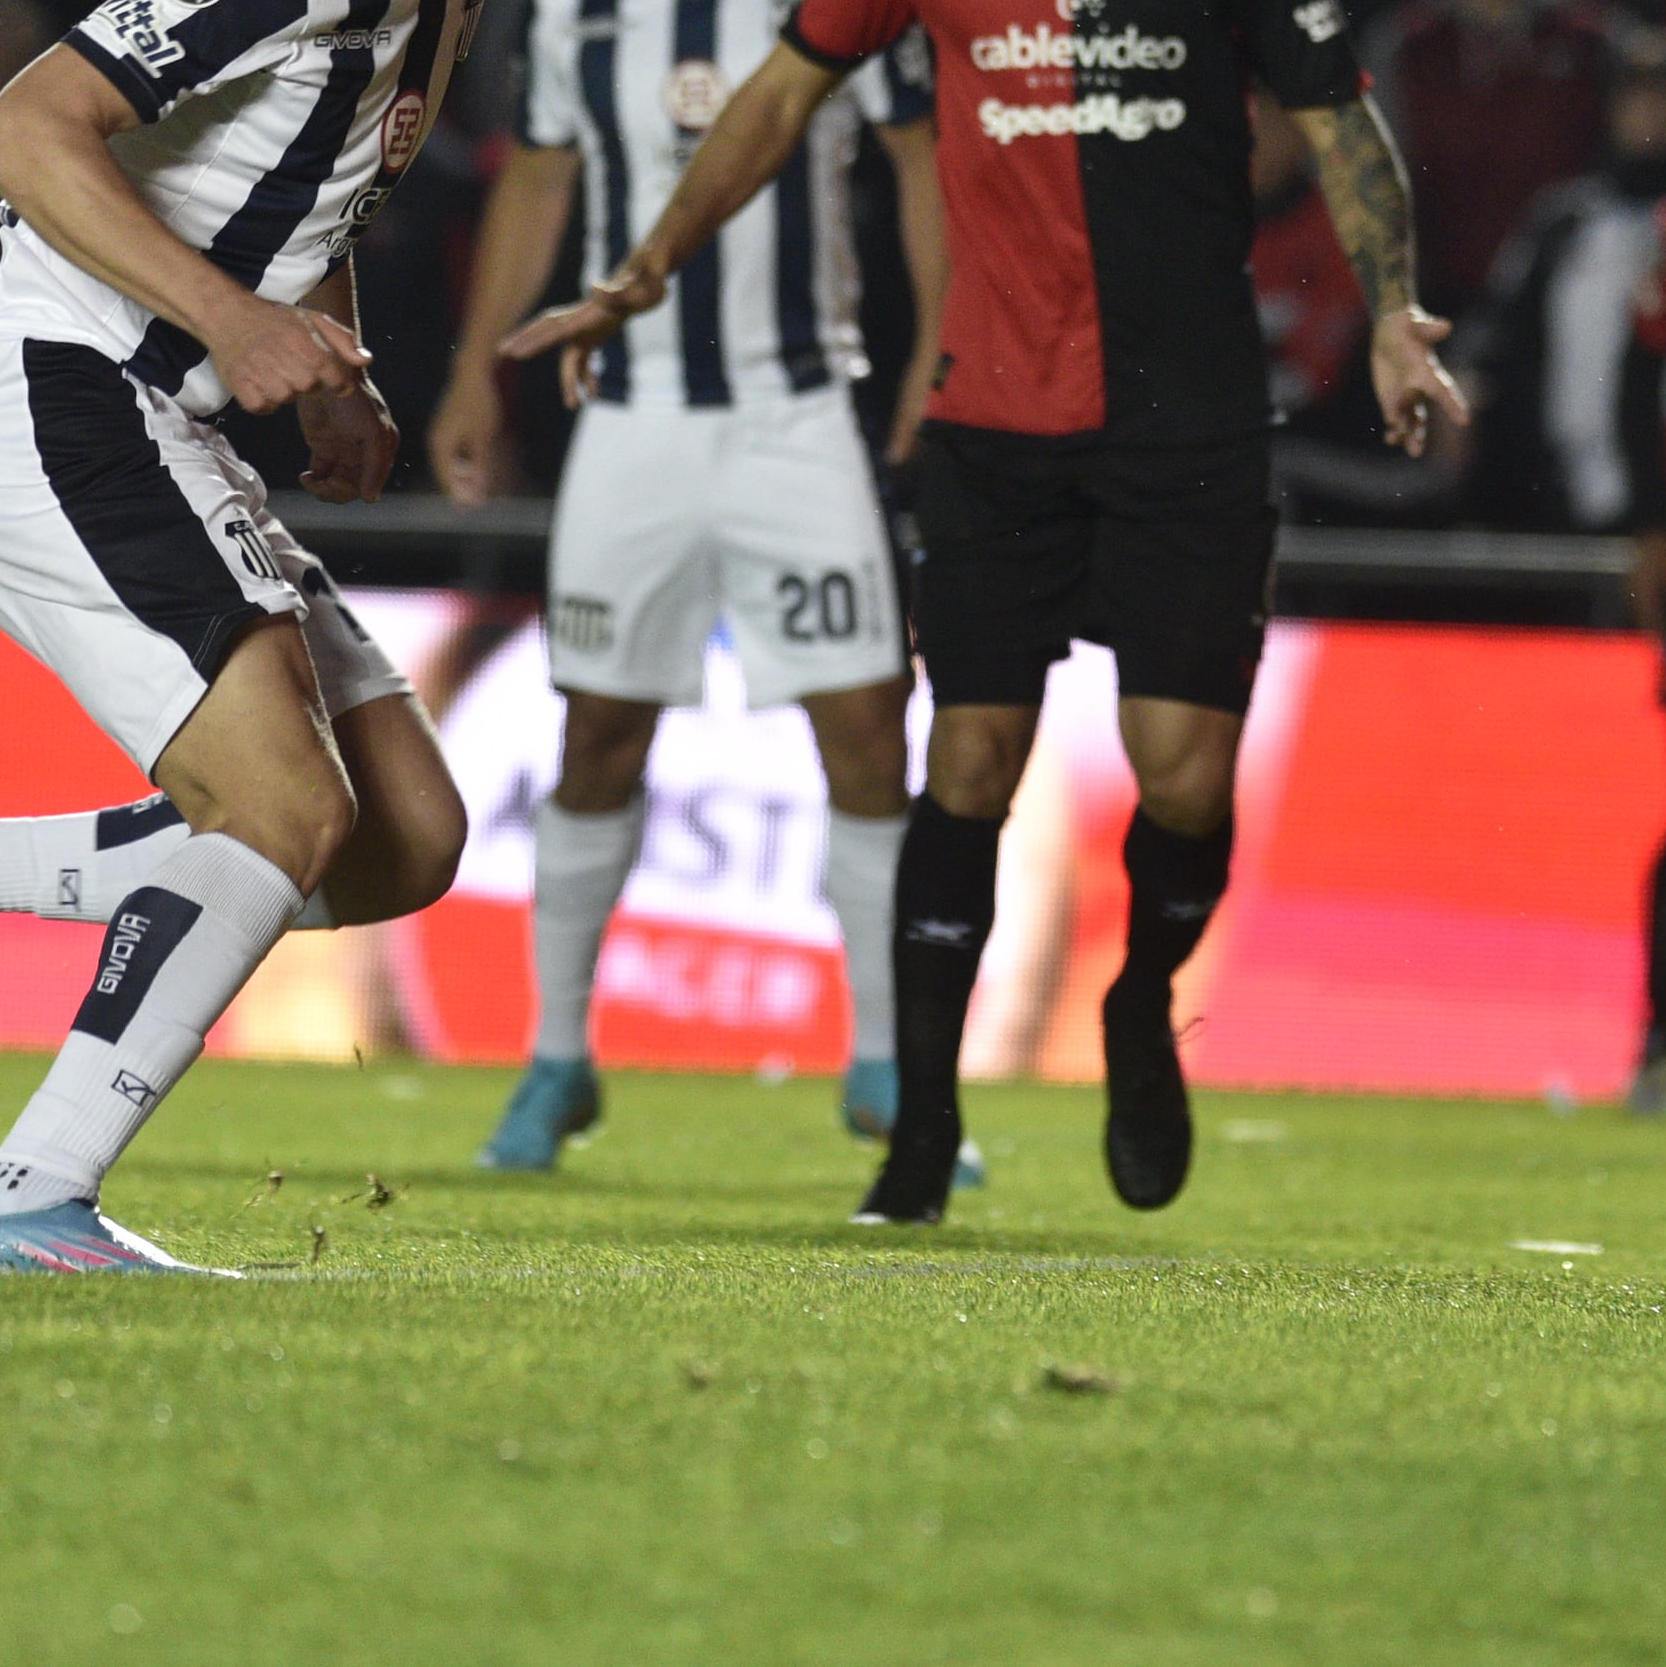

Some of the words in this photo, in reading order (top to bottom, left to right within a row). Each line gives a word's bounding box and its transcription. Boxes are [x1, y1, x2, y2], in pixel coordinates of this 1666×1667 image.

[313, 29, 391, 50] GIVOVA
[970, 22, 1187, 70] cablevideo
[978, 94, 1185, 145] SpeedAgro
[779, 571, 859, 644] 20
[97, 913, 151, 994] GIVOVA
